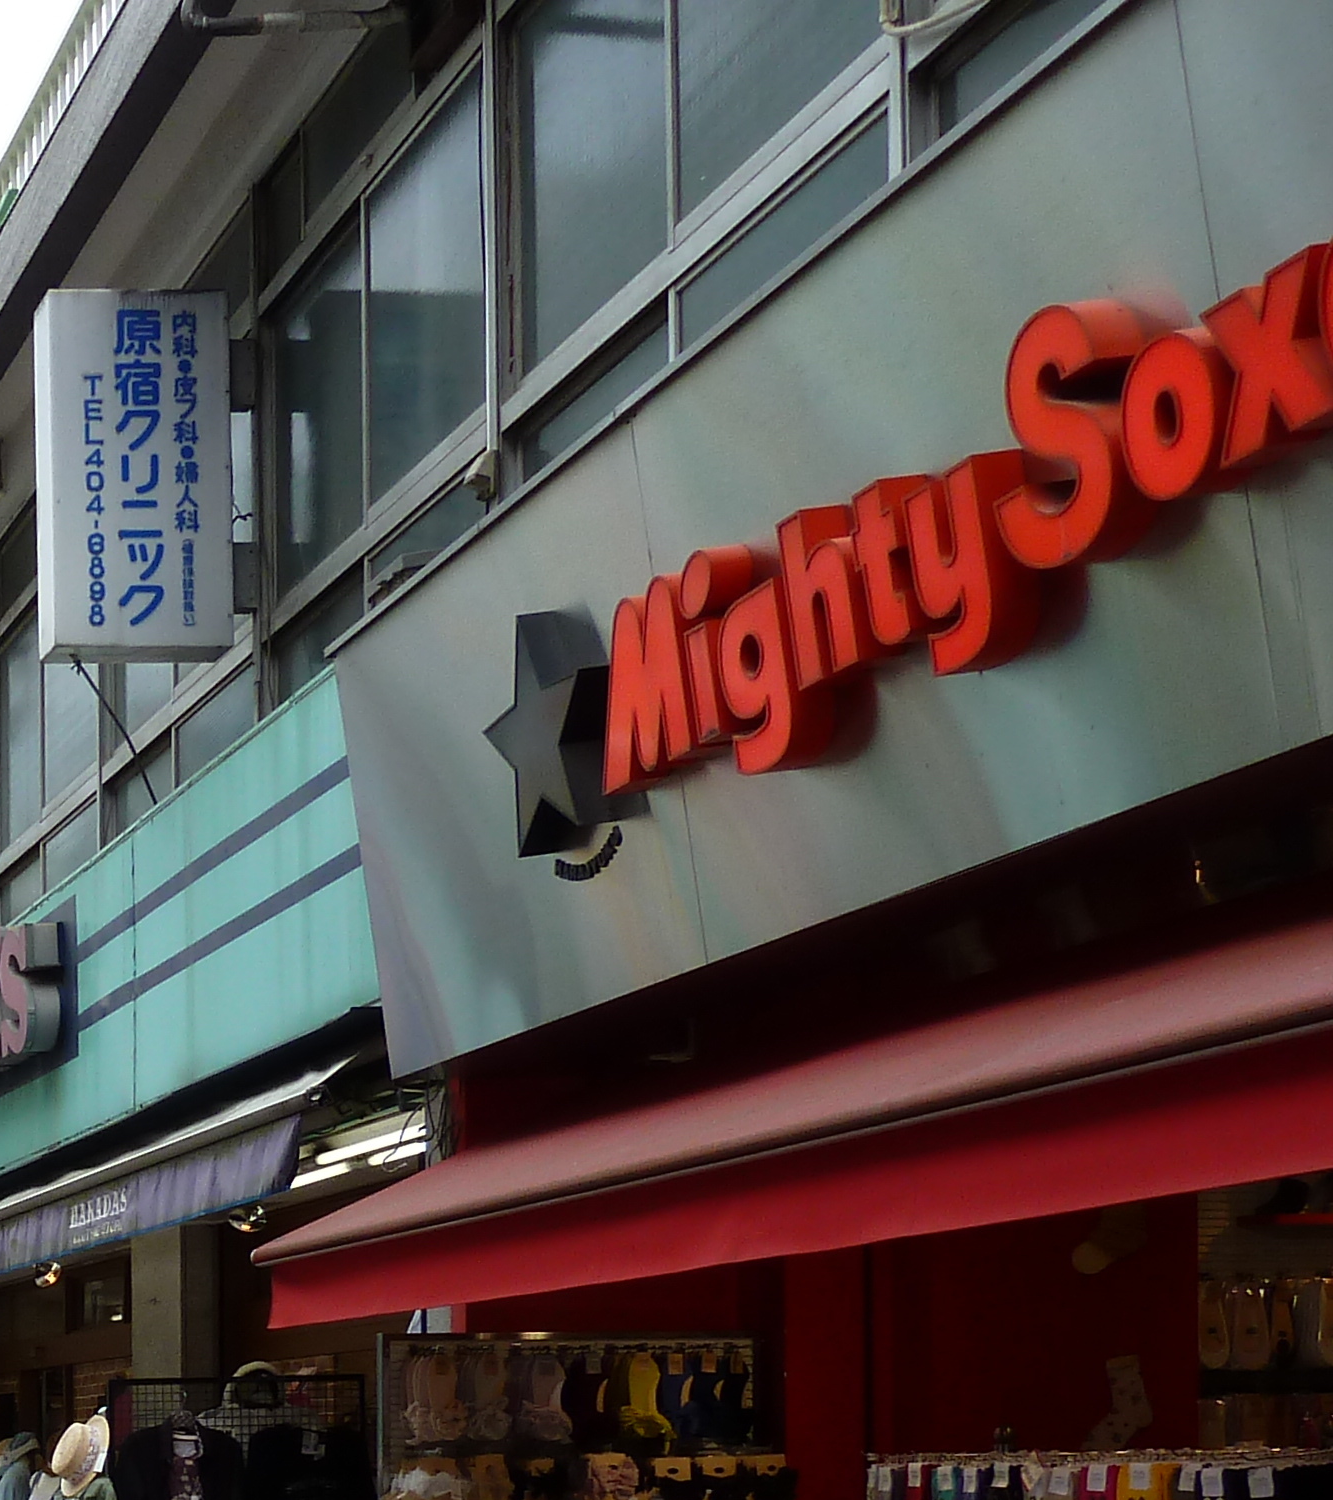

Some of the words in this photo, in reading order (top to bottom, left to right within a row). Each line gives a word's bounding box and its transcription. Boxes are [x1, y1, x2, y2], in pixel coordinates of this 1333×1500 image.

[113, 309, 165, 627] 原宿クリニック
[603, 450, 1023, 796] Mighty
[995, 242, 1333, 571] Sox
